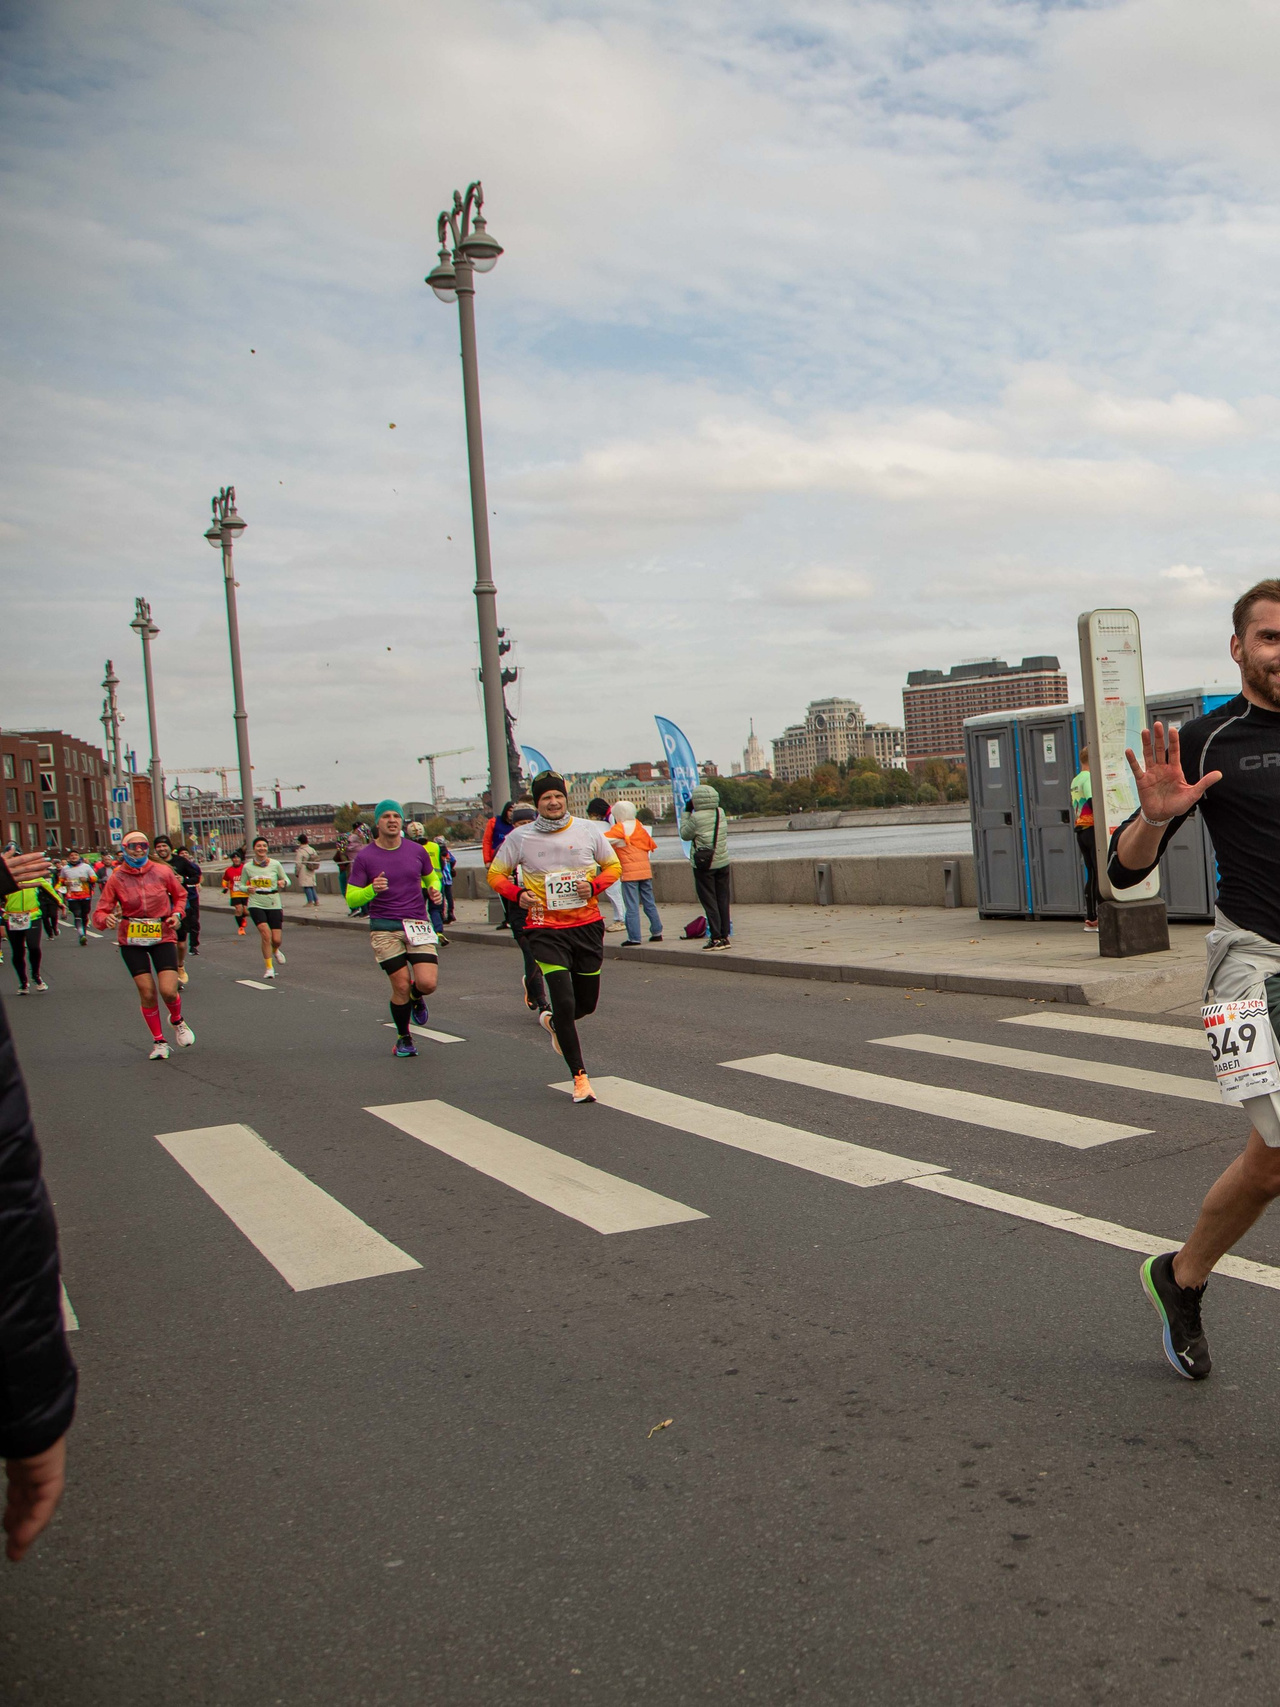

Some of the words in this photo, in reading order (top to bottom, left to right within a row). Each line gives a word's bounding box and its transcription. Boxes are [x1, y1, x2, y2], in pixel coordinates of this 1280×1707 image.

[130, 924, 161, 934] 11084
[410, 924, 432, 934] 1196
[1248, 1000, 1265, 1009] КМ
[1207, 1023, 1257, 1062] 349
